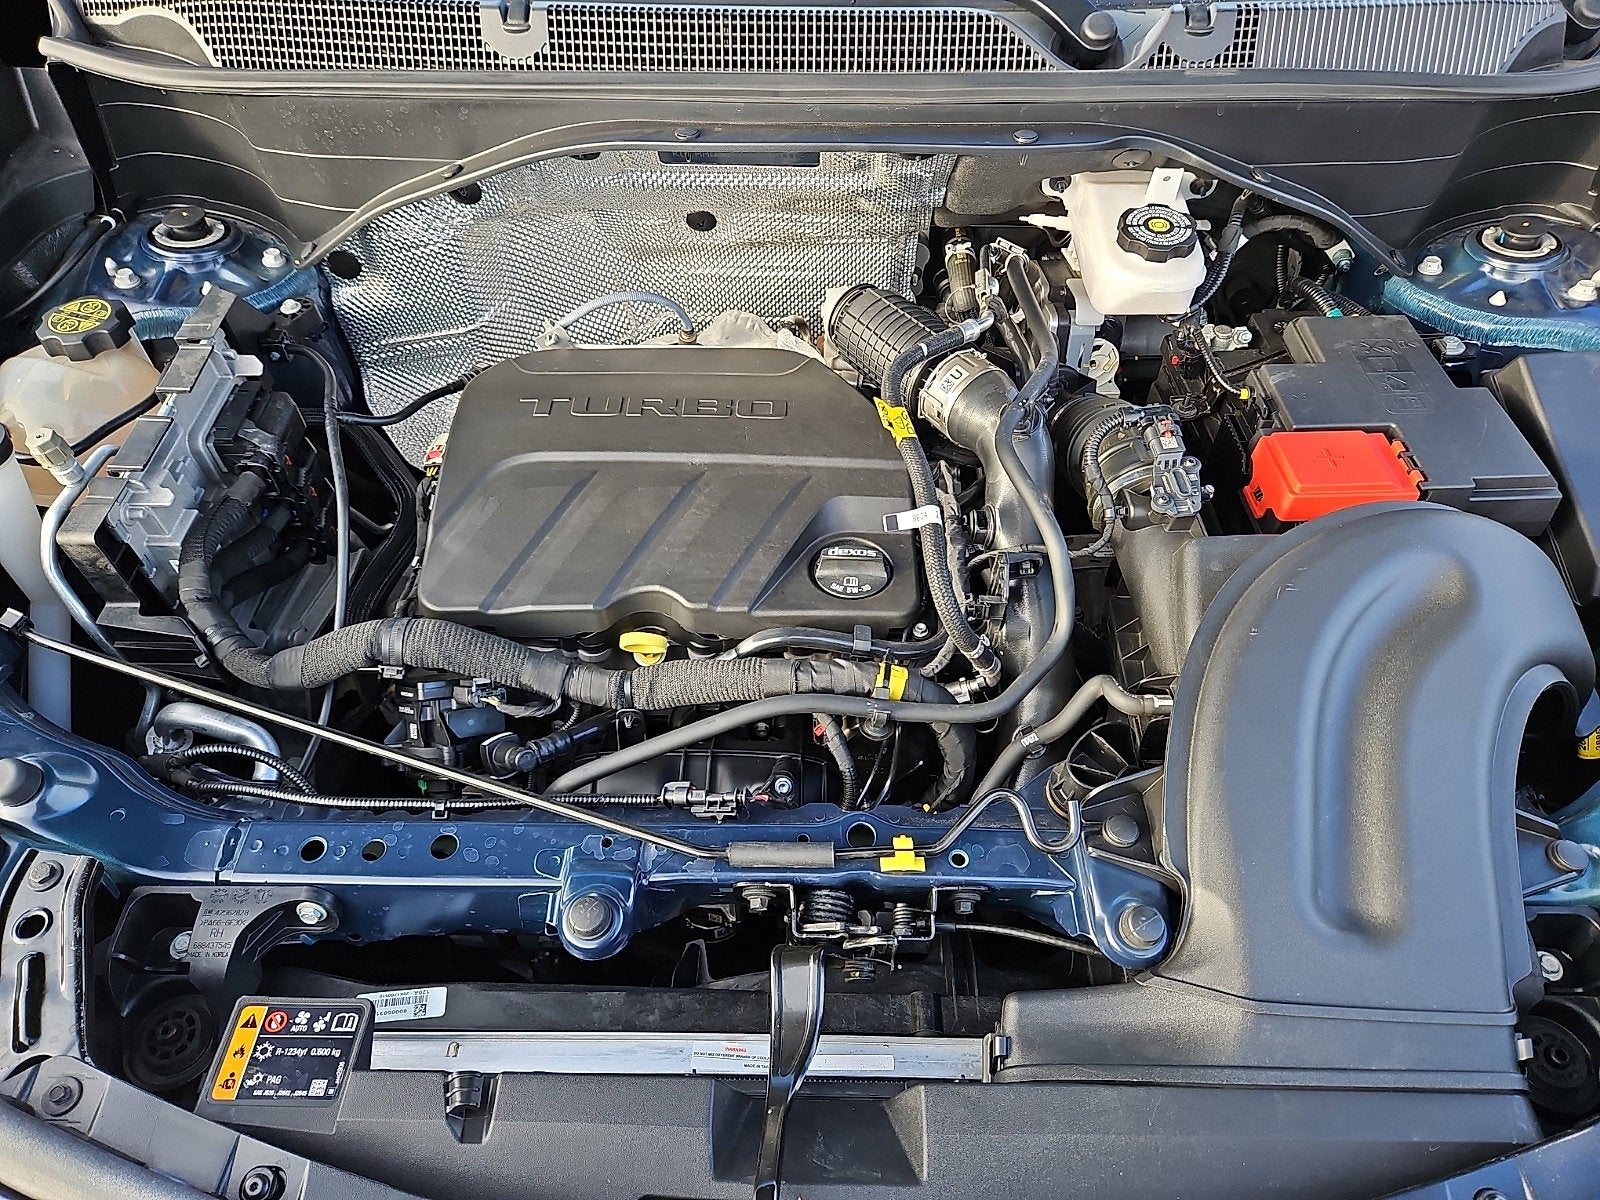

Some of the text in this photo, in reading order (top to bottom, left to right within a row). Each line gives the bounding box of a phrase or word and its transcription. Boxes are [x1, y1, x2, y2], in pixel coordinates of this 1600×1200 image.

[519, 397, 789, 419] TURBO
[827, 546, 878, 557] dexos
[830, 583, 872, 593] SAE 5W-30
[209, 928, 225, 938] RH
[290, 1025, 308, 1033] AUTO
[275, 1047, 309, 1058] R-1234yf
[331, 1047, 342, 1058] kg
[265, 1075, 283, 1084] PAG
